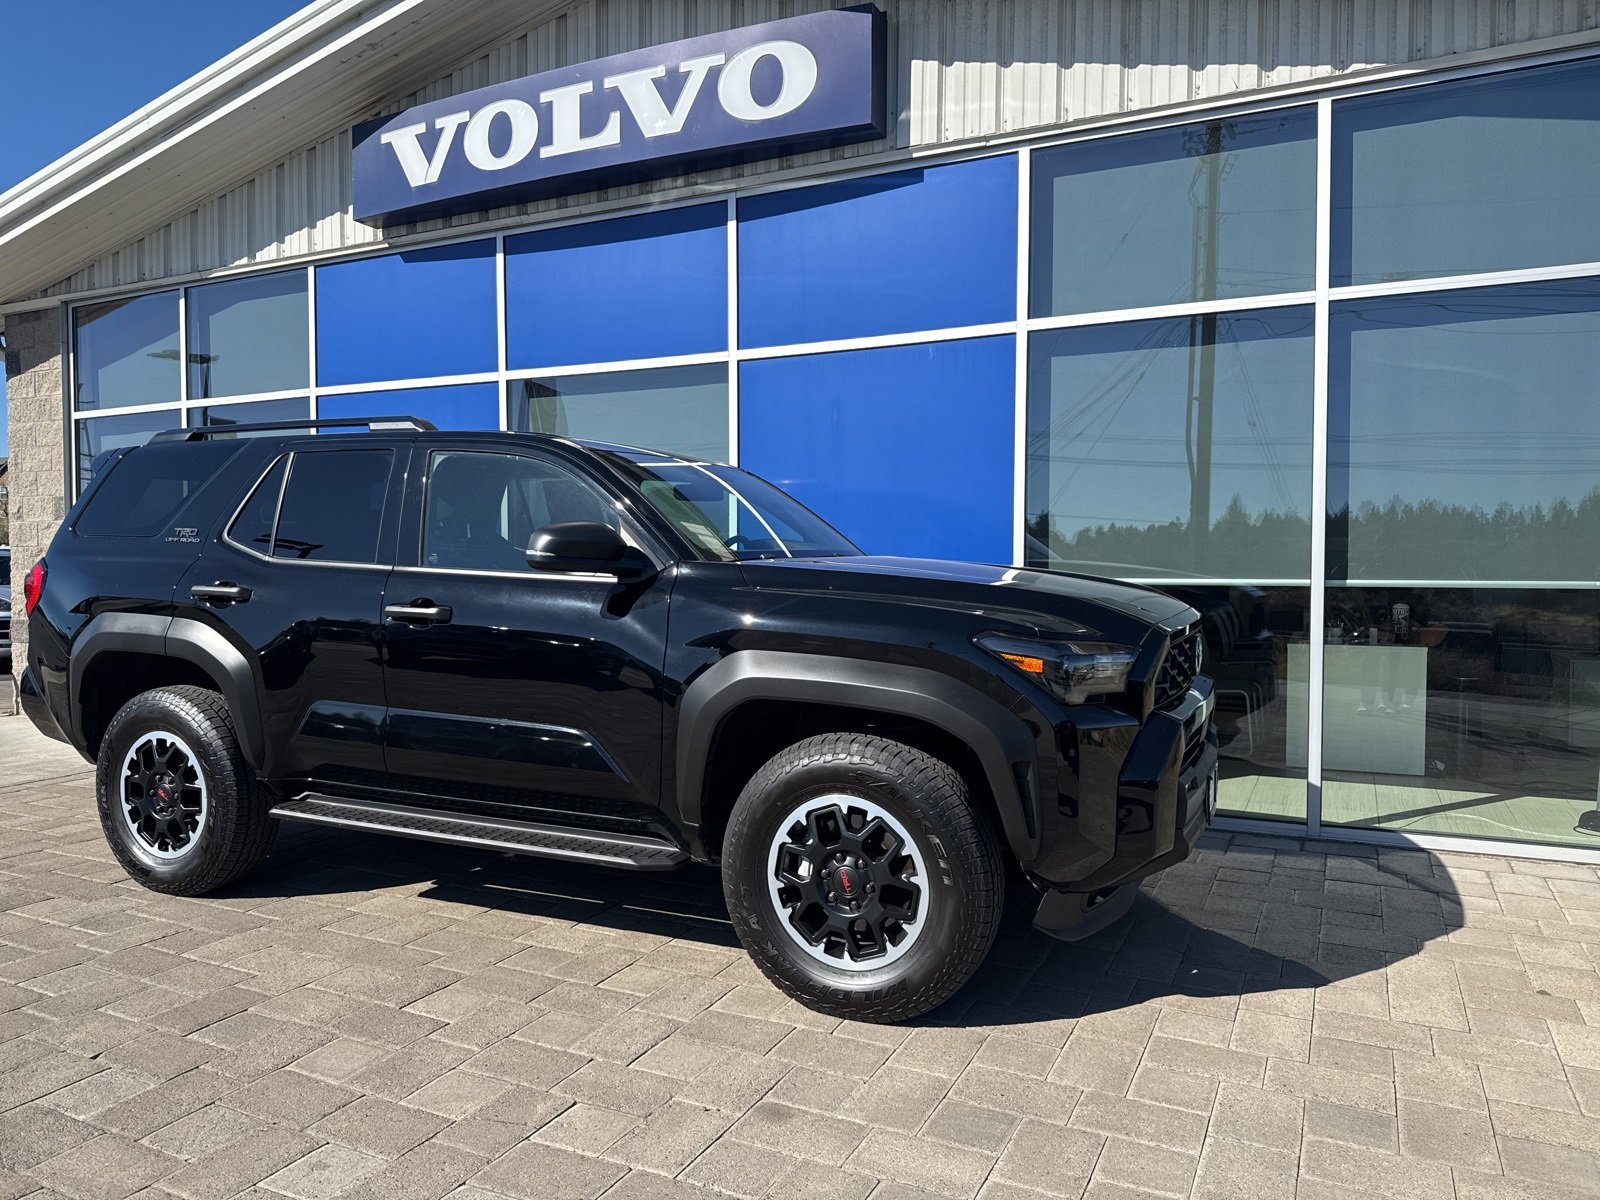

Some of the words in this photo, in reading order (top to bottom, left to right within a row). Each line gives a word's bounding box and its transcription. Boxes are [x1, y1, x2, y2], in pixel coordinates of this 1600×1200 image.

[380, 40, 817, 188] VOLVO
[174, 527, 198, 538] TRD
[840, 869, 851, 893] TRD
